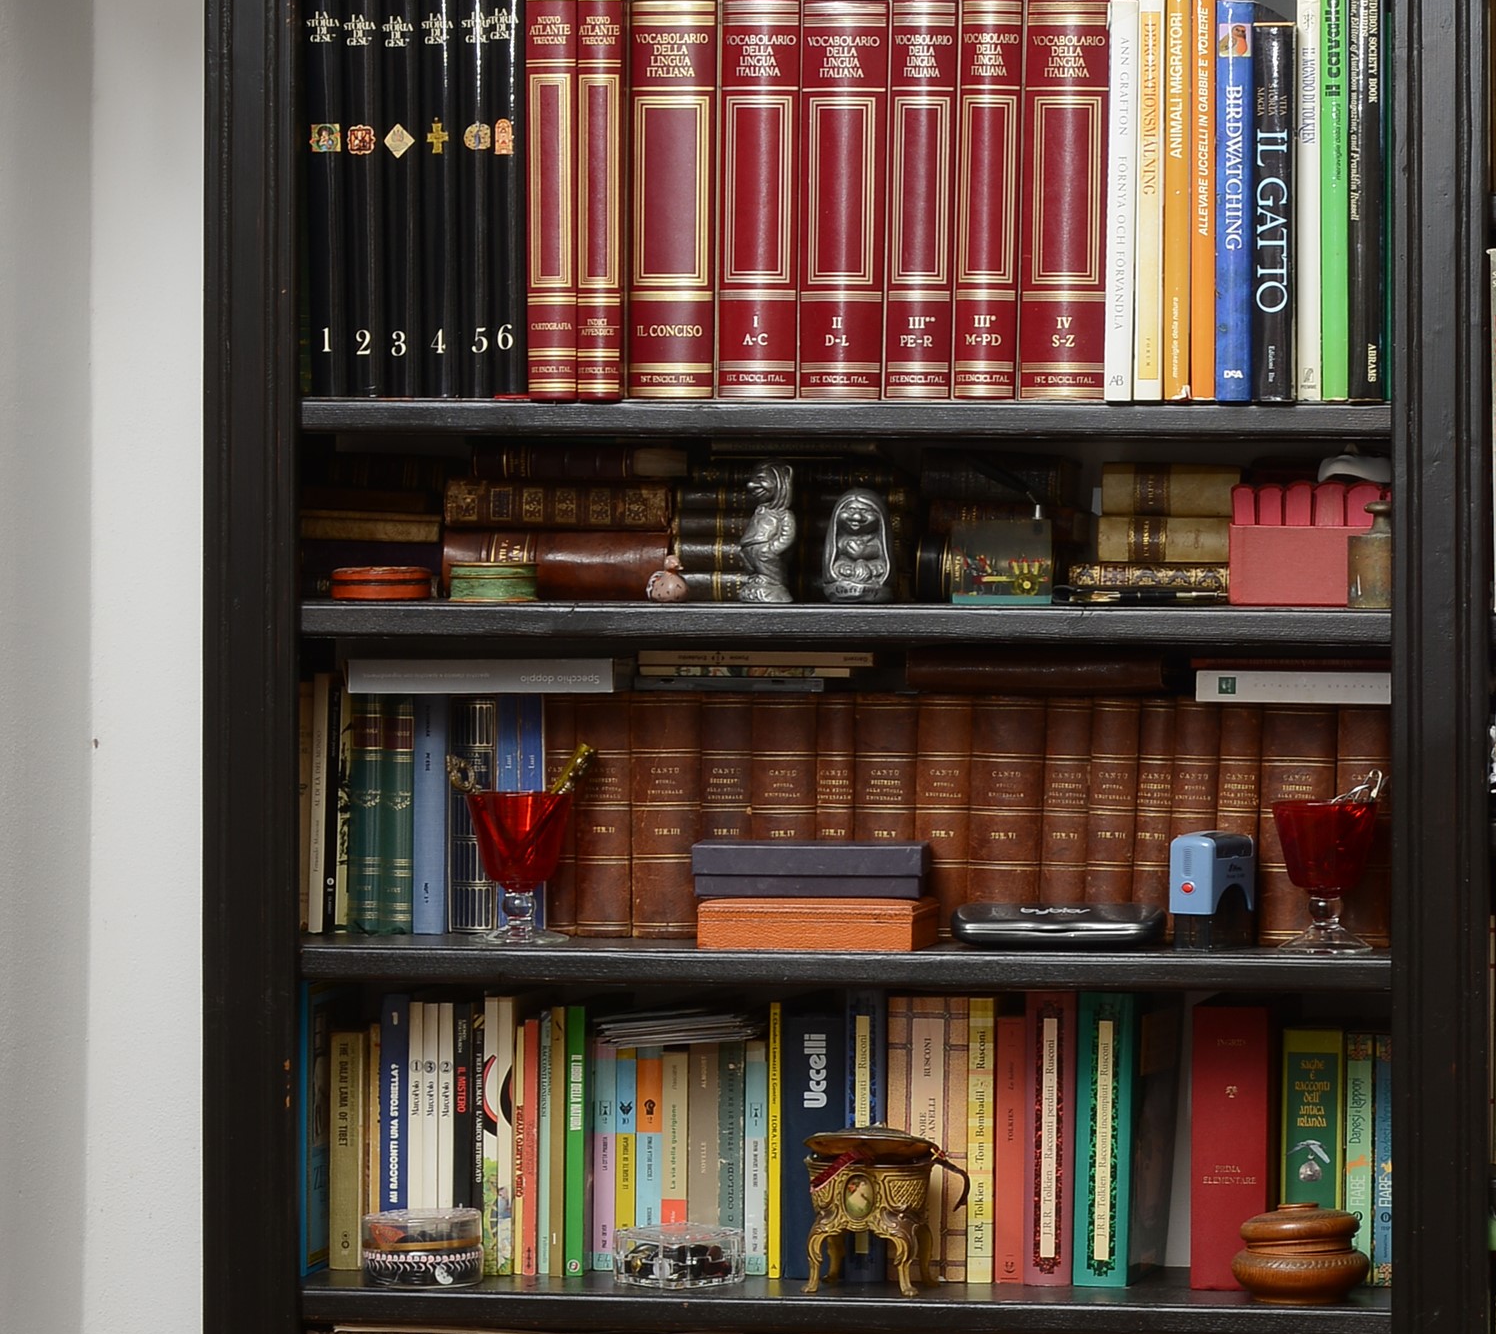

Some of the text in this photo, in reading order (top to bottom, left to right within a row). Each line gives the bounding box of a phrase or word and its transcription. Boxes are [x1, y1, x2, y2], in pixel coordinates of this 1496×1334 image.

[636, 34, 708, 44] VOCABOLARIO
[654, 45, 688, 55] DELLA
[646, 67, 695, 77] ITALIANA
[650, 56, 691, 67] LINGUA
[1169, 12, 1182, 159] ANIMALI MIGRATORI
[1224, 85, 1242, 250] BIRDWATCHING
[1255, 129, 1287, 314] IL GATTO
[322, 328, 331, 352] 1
[355, 330, 371, 355] 2
[391, 331, 406, 356] 3
[431, 329, 446, 354] 4
[472, 327, 488, 352] 5
[497, 324, 513, 350] 6
[637, 325, 702, 337] IL CONCISO
[803, 1033, 826, 1108] Uccelli
